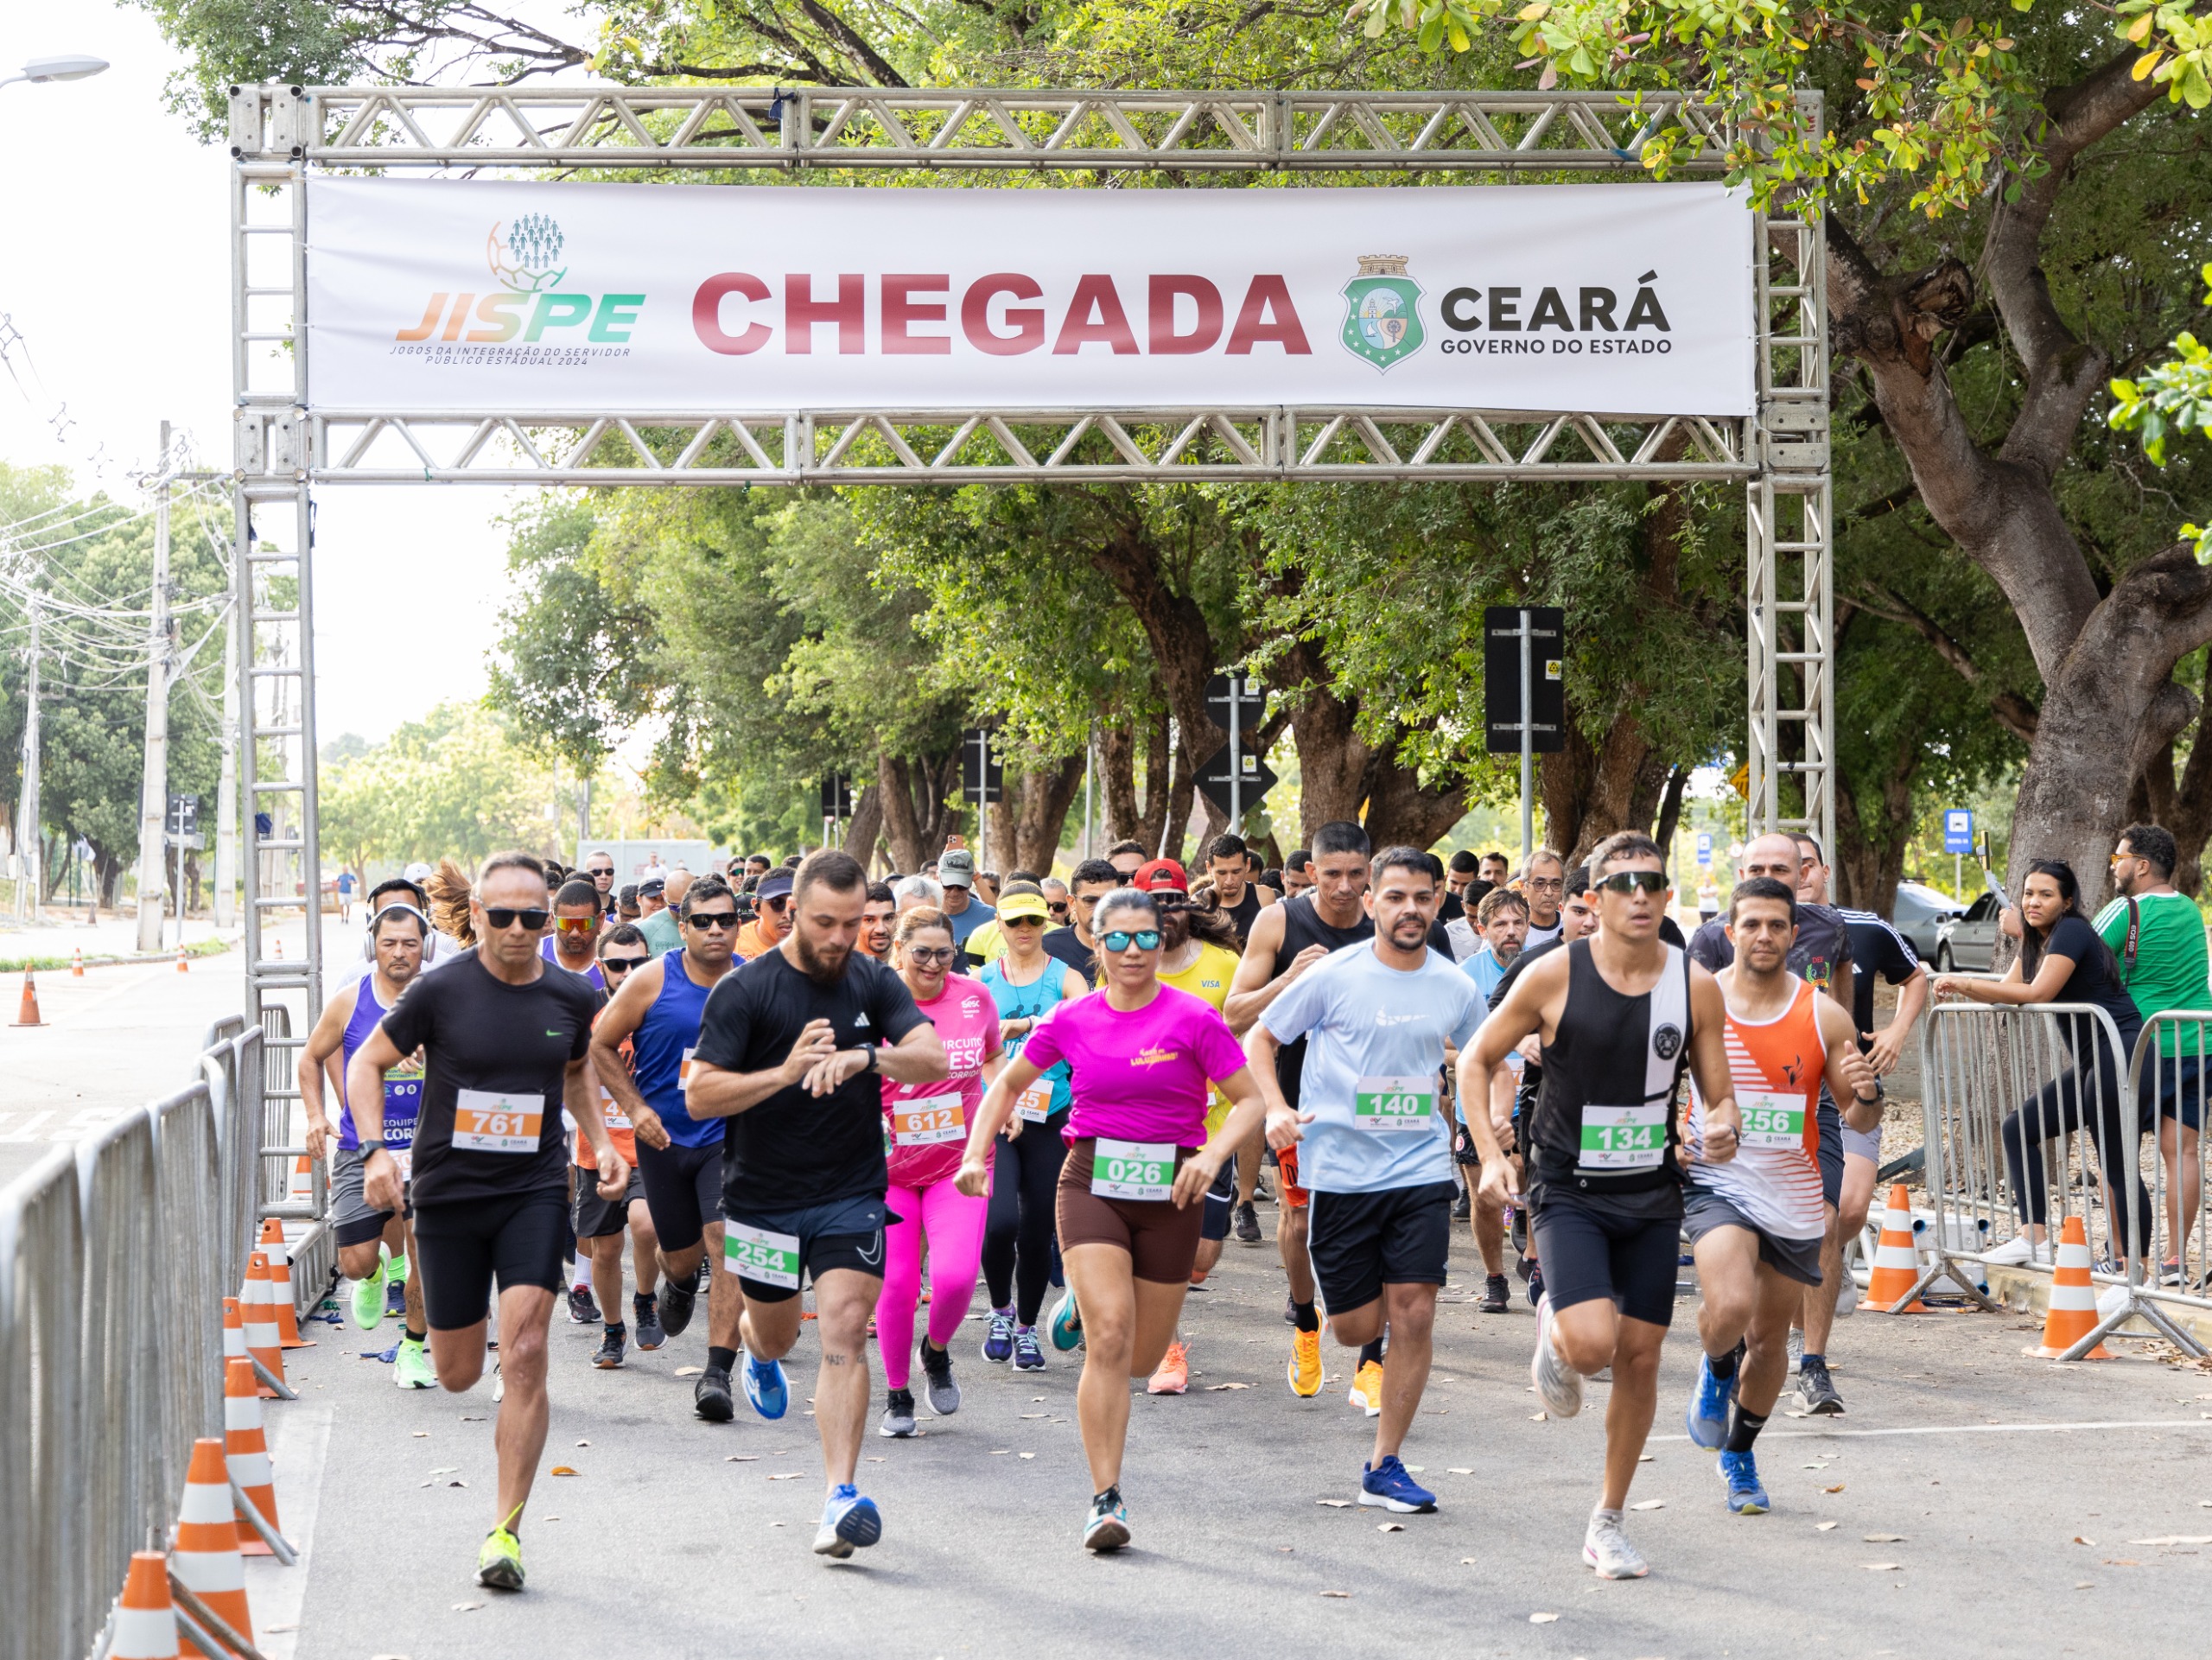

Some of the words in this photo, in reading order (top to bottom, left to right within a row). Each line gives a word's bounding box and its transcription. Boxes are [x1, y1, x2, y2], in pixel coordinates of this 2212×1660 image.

[1440, 270, 1671, 332] CEARÁ
[395, 292, 646, 342] JISPE
[692, 273, 1311, 354] CHEGADA
[390, 347, 432, 355] JOGOS
[456, 346, 540, 358] INTEGRAÇÃO
[543, 347, 561, 356] DO
[565, 348, 631, 357] SERVIDOR
[1440, 339, 1546, 354] GOVERNO
[1552, 339, 1583, 354] DO
[1590, 339, 1672, 354] ESTADO
[425, 354, 483, 365] PÚBLICO
[486, 356, 554, 366] ESTADUAL
[557, 357, 589, 366] 2024
[1370, 1094, 1419, 1115] 140
[383, 1118, 418, 1128] EQUIPE
[472, 1111, 524, 1135] 761
[907, 1110, 954, 1131] 612
[1740, 1109, 1789, 1133] 256
[1598, 1126, 1652, 1150] 134
[1108, 1159, 1161, 1184] 026
[737, 1242, 785, 1271] 254
